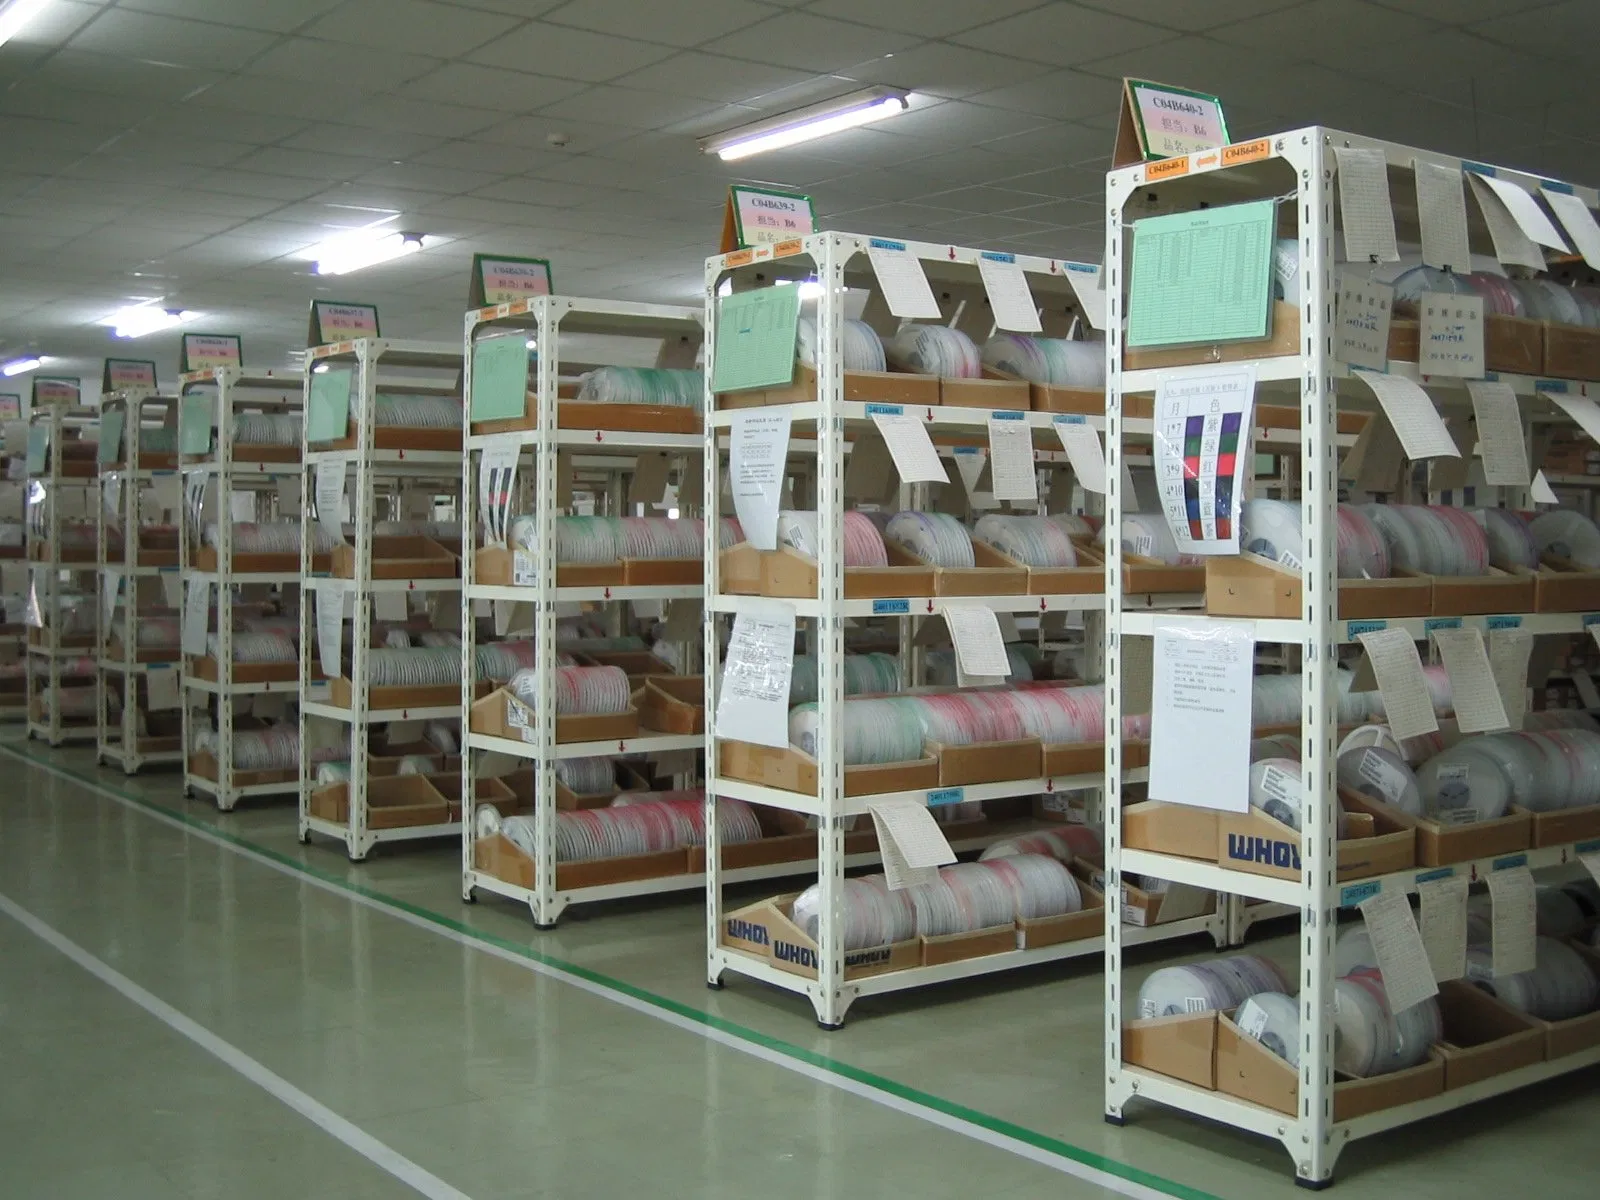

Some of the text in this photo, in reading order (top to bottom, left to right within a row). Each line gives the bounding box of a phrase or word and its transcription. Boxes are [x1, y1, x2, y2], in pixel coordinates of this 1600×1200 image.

[1153, 97, 1204, 116] C04B640-2
[1171, 398, 1221, 416] 月 色
